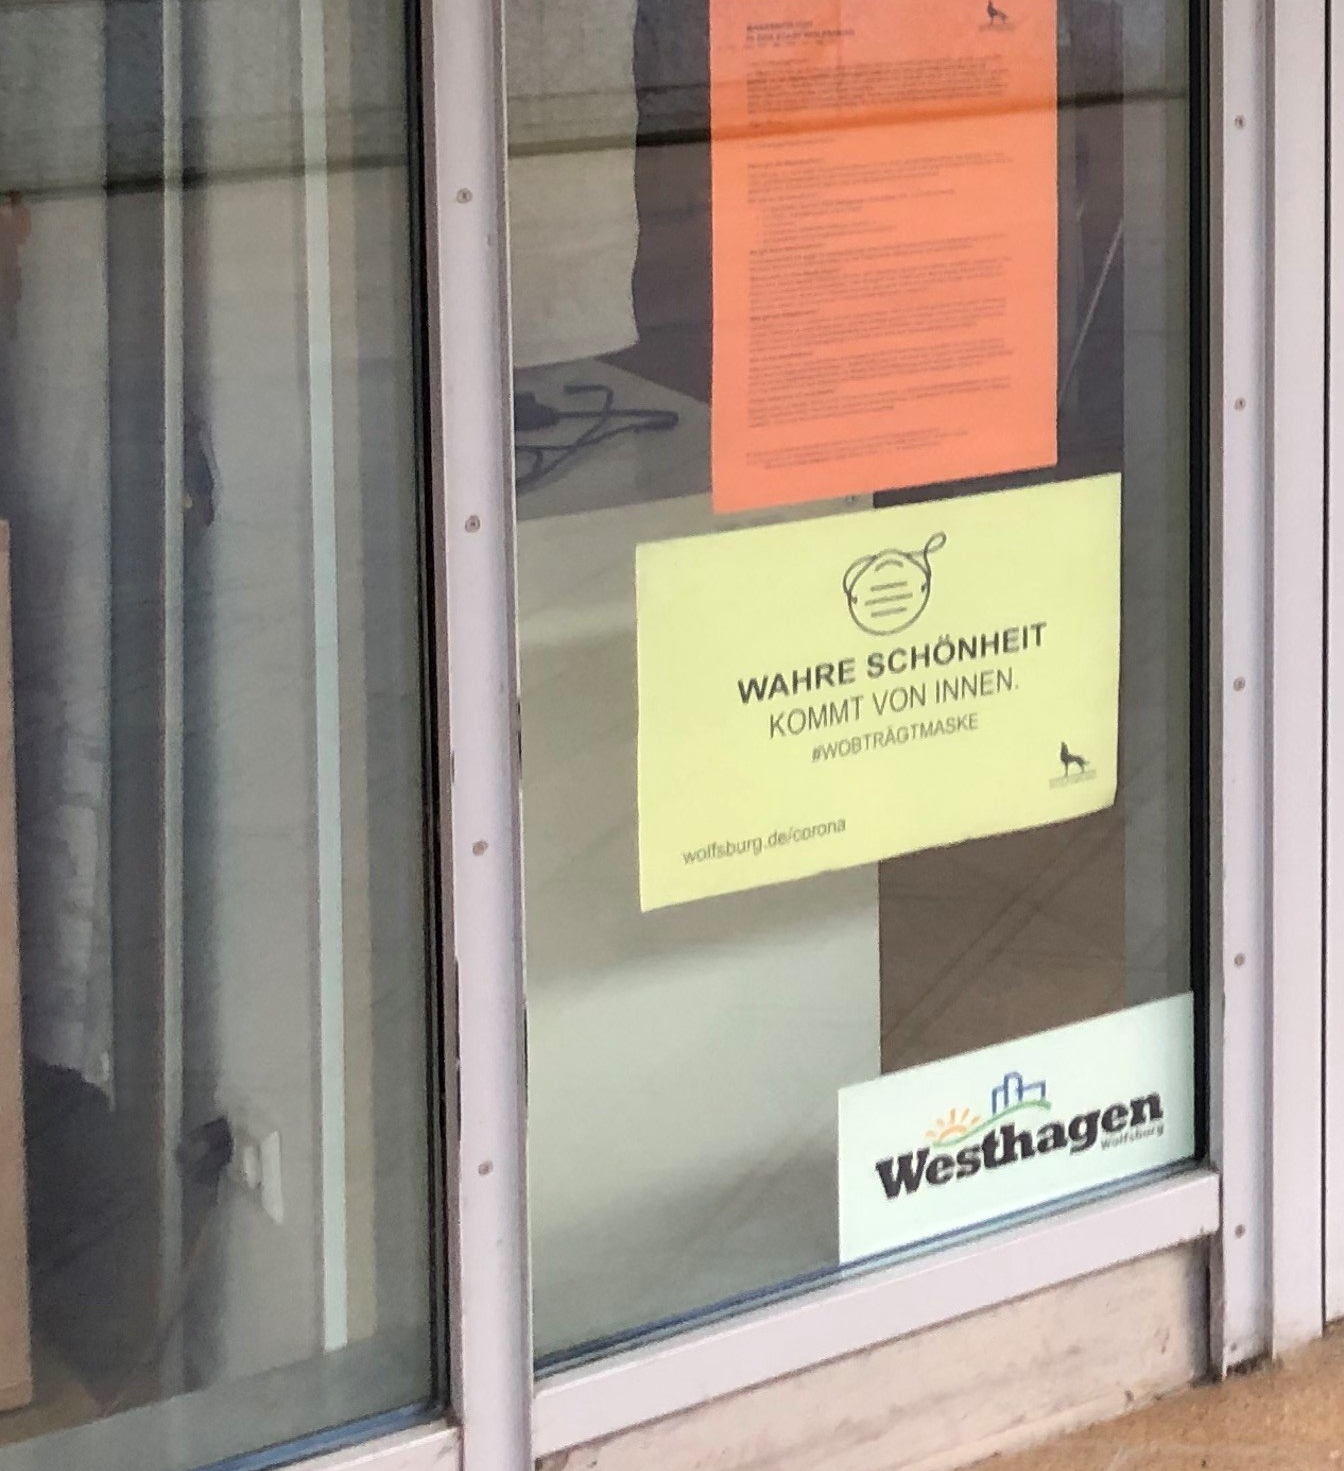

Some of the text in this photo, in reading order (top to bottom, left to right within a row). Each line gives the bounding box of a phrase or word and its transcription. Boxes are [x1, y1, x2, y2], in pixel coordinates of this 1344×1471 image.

[736, 620, 1047, 705] WAHRE SCHÖNHEIT
[769, 666, 1020, 740] KOMMT VON INNEN.
[810, 711, 979, 763] #WOBTRÄGTMASKE
[681, 817, 847, 865] wolfsburg.de/corona
[875, 1091, 1165, 1201] Westhagen
